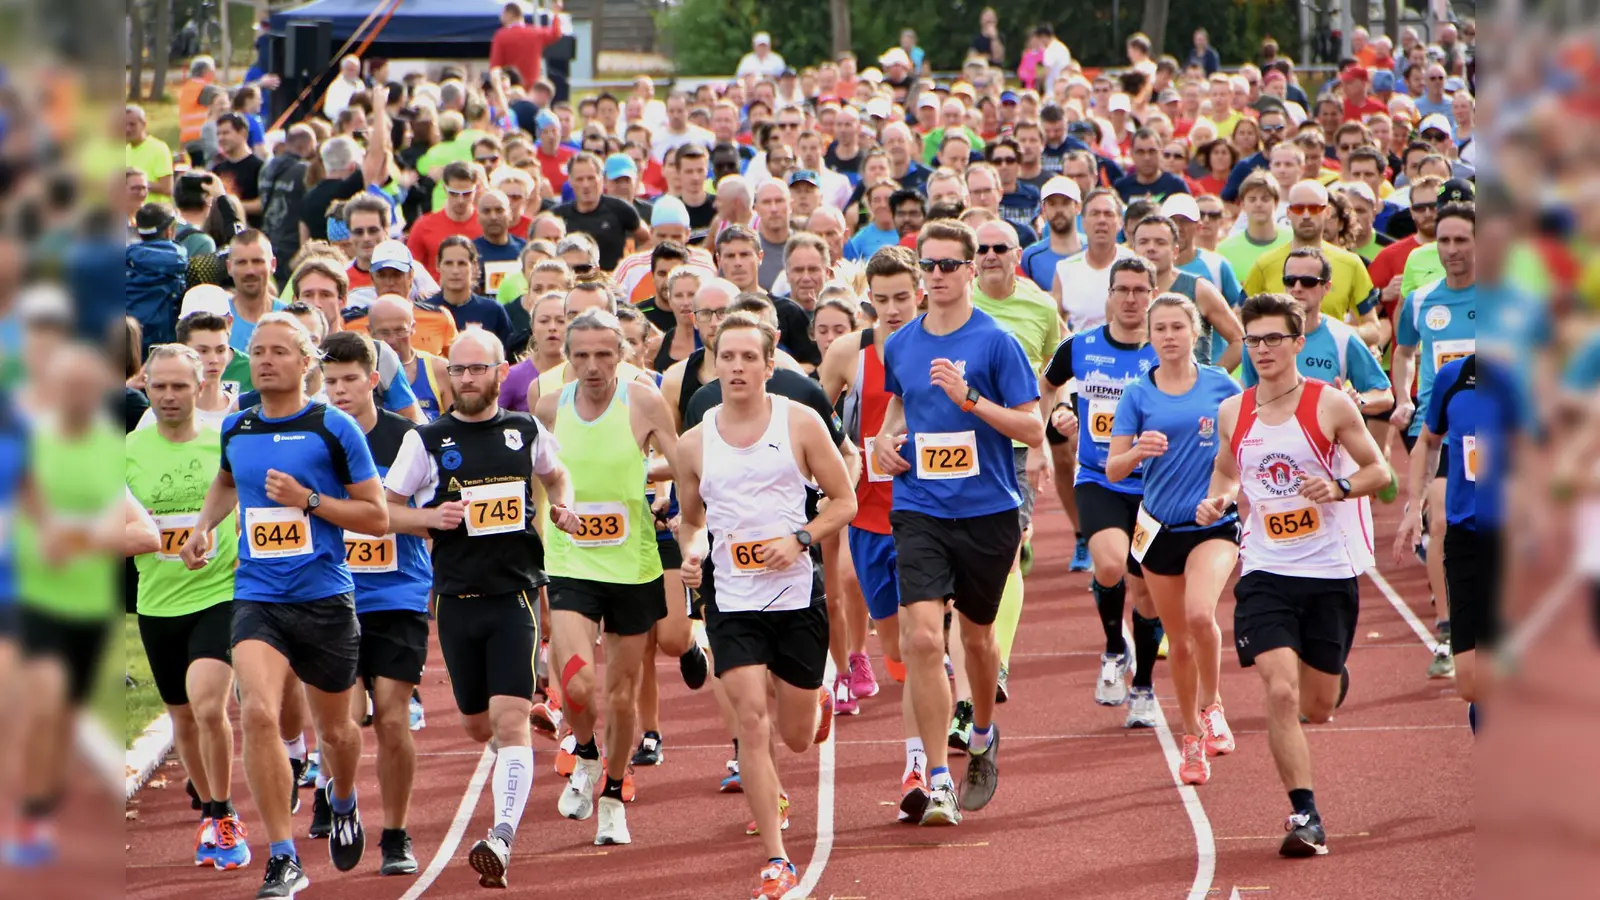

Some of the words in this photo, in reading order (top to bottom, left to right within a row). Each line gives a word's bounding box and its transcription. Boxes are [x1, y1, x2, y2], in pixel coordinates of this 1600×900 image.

[1305, 356, 1333, 370] GVG
[1085, 385, 1124, 397] LIFEPAR
[1095, 415, 1115, 433] 6
[925, 448, 968, 469] 722
[1258, 452, 1300, 473] SPORTVEREIN
[462, 478, 484, 487] Team
[1255, 472, 1271, 480] SVG
[474, 499, 519, 524] 745
[576, 516, 619, 537] 633
[1269, 510, 1315, 536] 654
[254, 523, 301, 547] 644
[344, 541, 386, 562] 731
